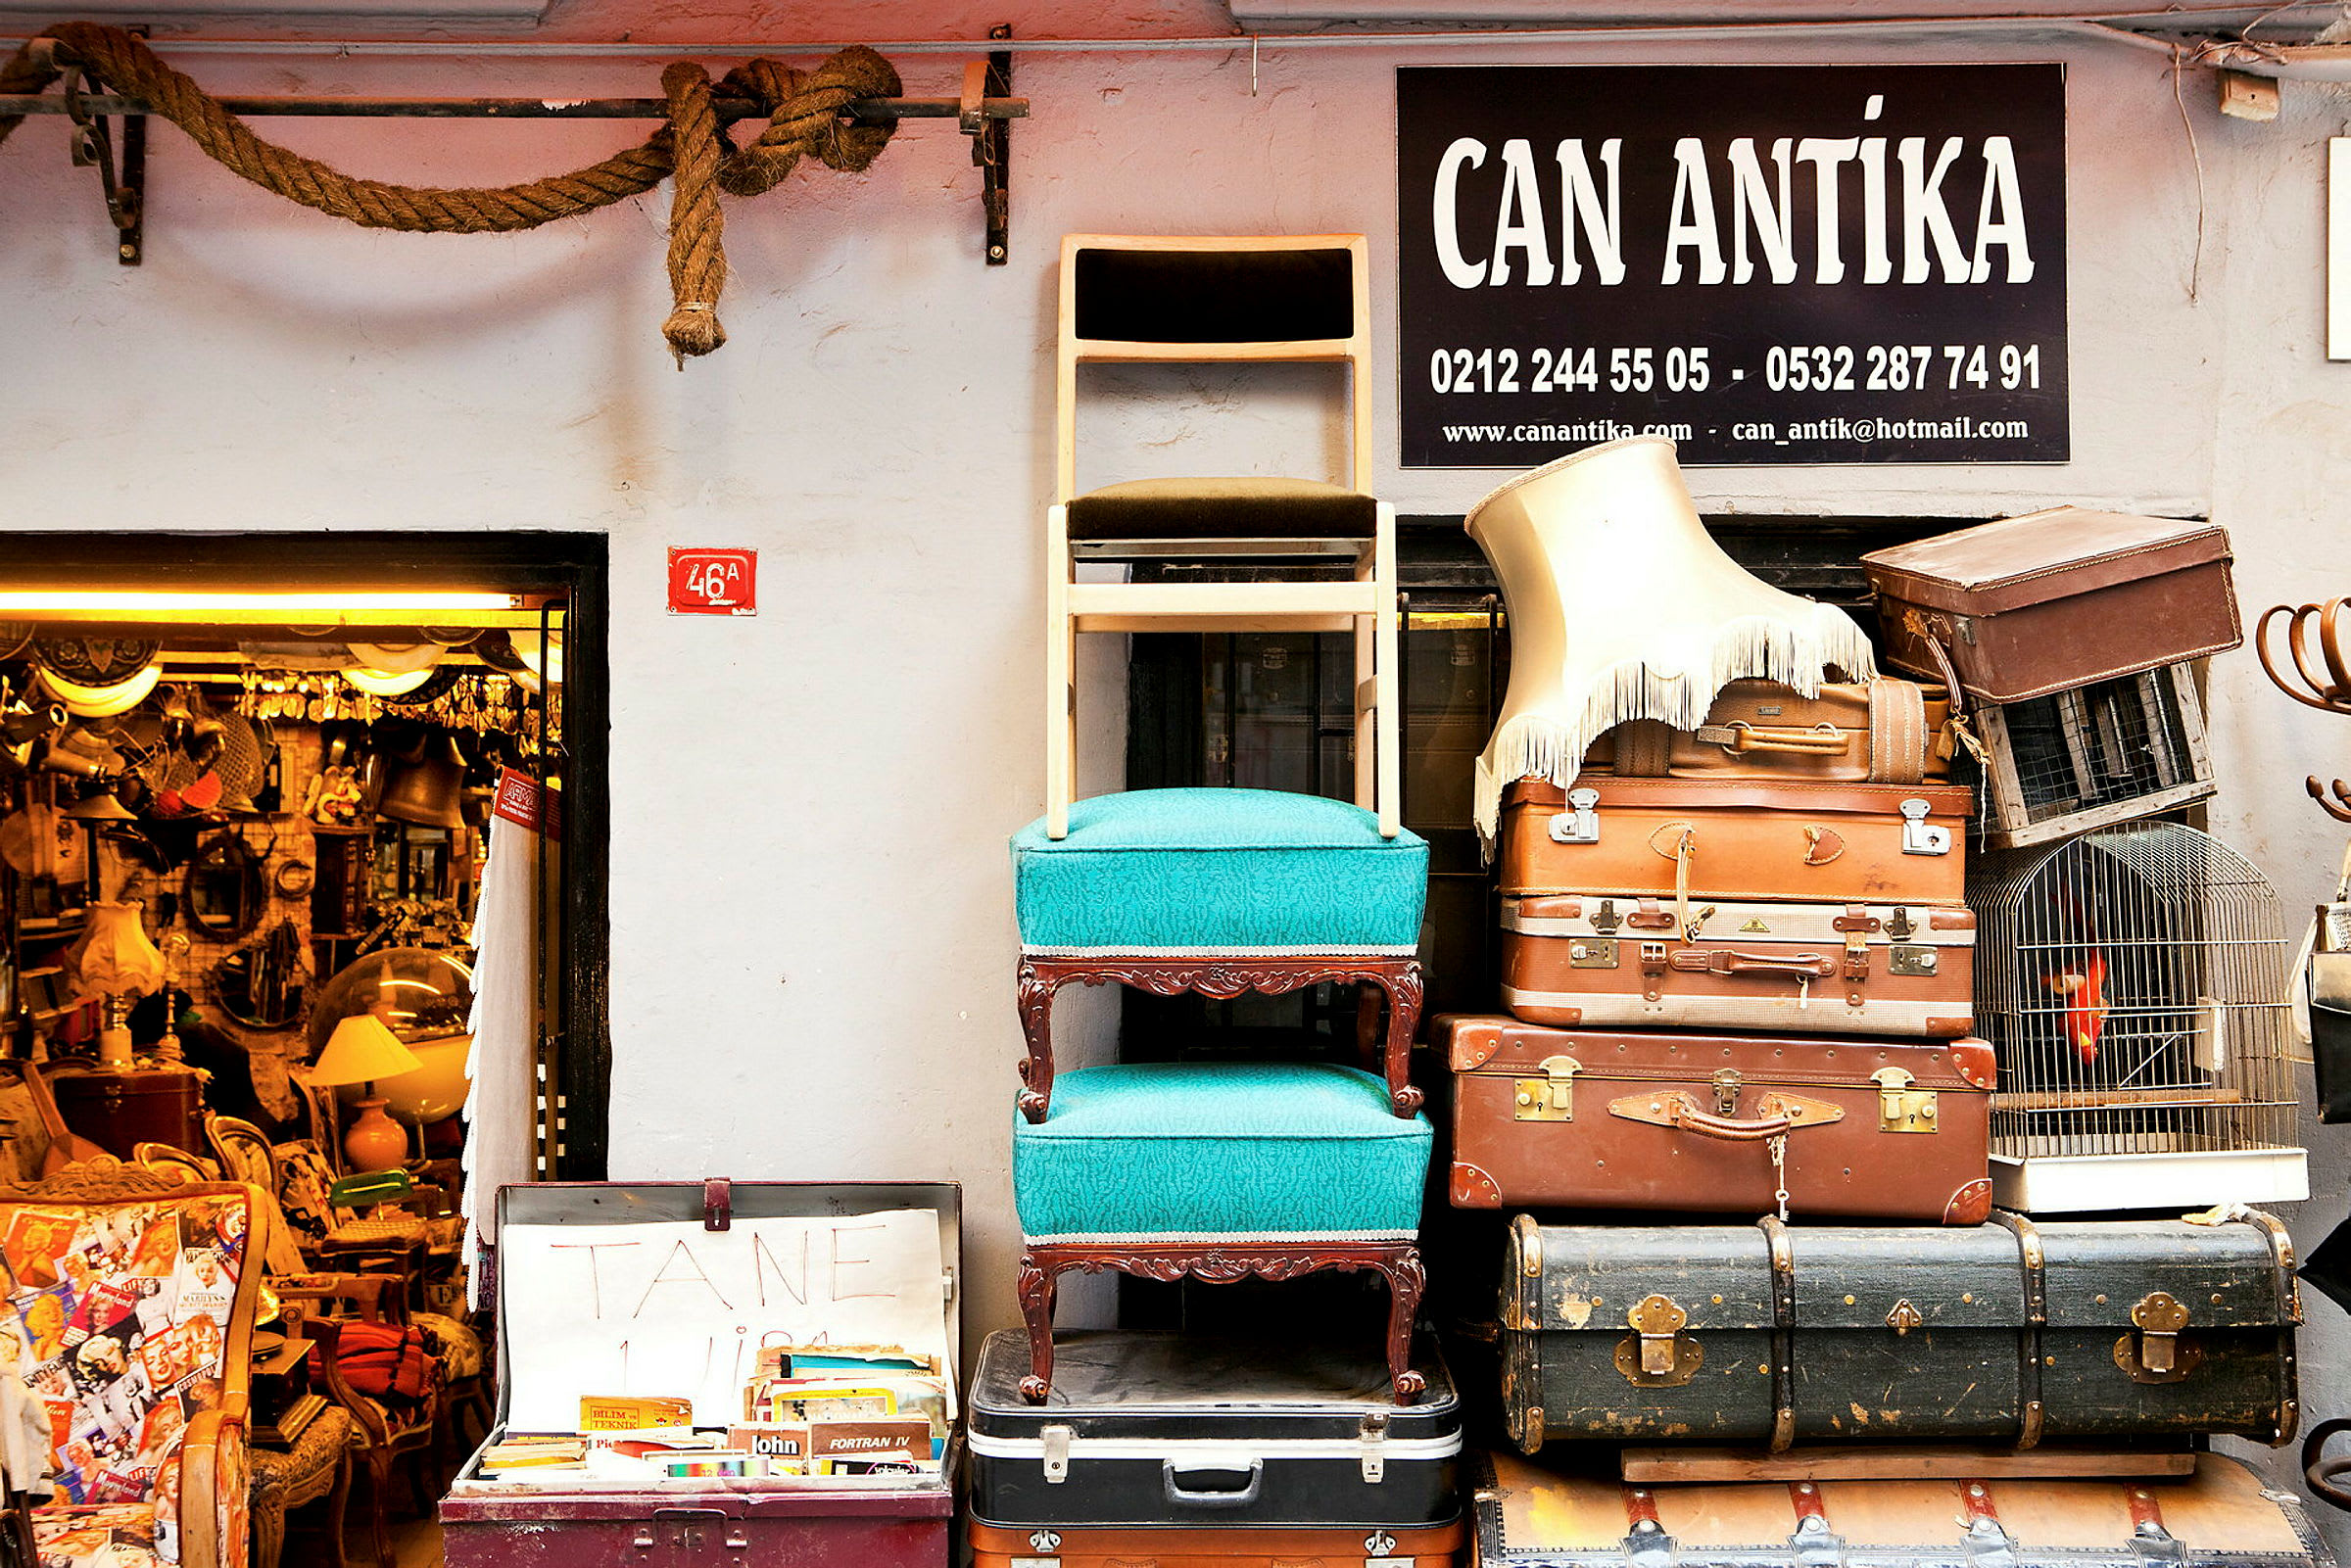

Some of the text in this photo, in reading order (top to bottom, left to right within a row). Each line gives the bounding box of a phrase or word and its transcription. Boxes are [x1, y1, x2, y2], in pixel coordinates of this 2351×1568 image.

[1433, 138, 1626, 288] CAN
[1431, 349, 1518, 393] 0212
[1531, 348, 1598, 392] 244
[1610, 348, 1654, 392] 55
[1666, 348, 1709, 392] 05
[1766, 346, 1853, 391] 0532
[1866, 346, 1931, 390] 287
[1944, 346, 1990, 390] 74
[2000, 345, 2039, 389] 91
[1442, 419, 1693, 442] www.canantikacom
[1732, 417, 2028, 447] can_antik@hotmail.com
[551, 1224, 897, 1320] TANE
[751, 1435, 797, 1454] John
[830, 1436, 910, 1449] FORTRAN IV
